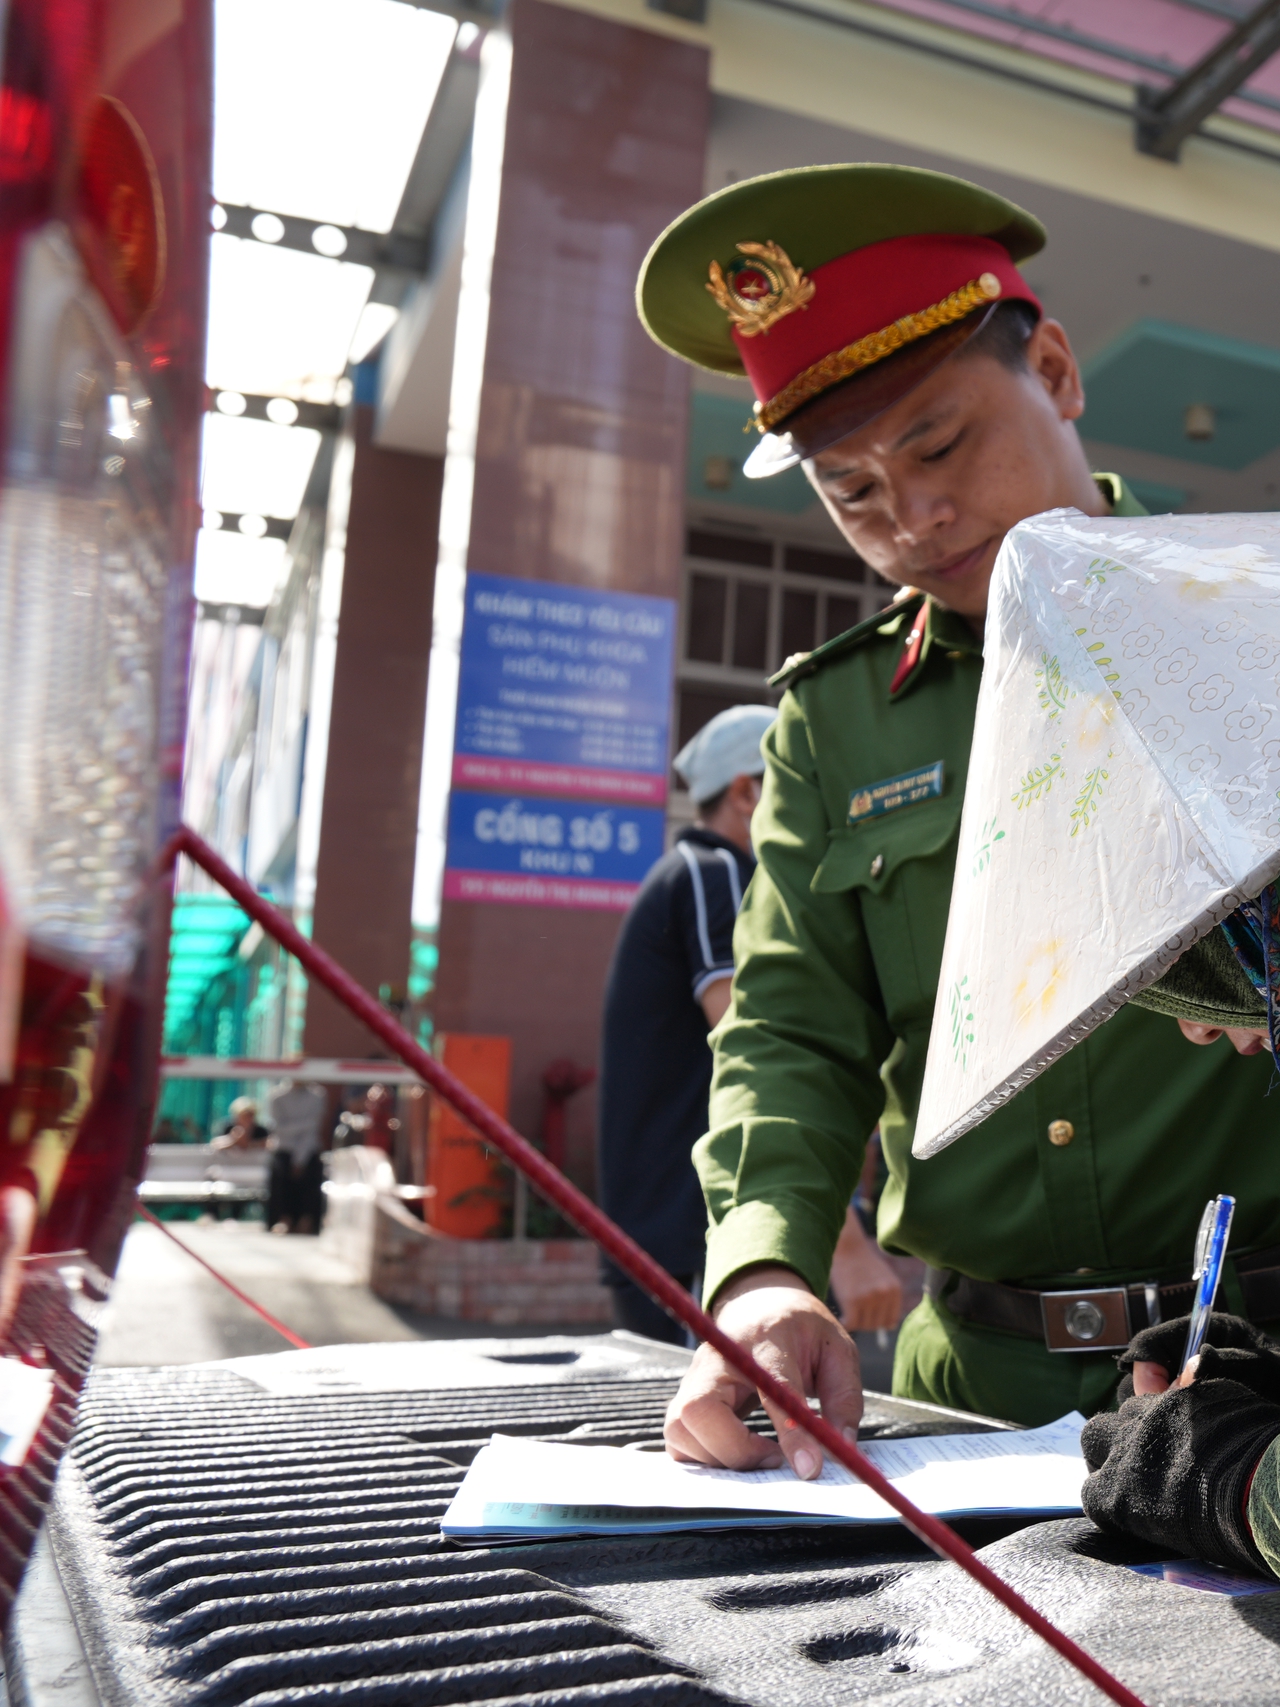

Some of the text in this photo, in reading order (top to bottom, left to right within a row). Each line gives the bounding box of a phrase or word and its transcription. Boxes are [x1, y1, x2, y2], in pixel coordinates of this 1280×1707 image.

[535, 598, 586, 629] THEO
[474, 799, 642, 855] CỔNG SỐ 5
[520, 849, 572, 874] KHU
